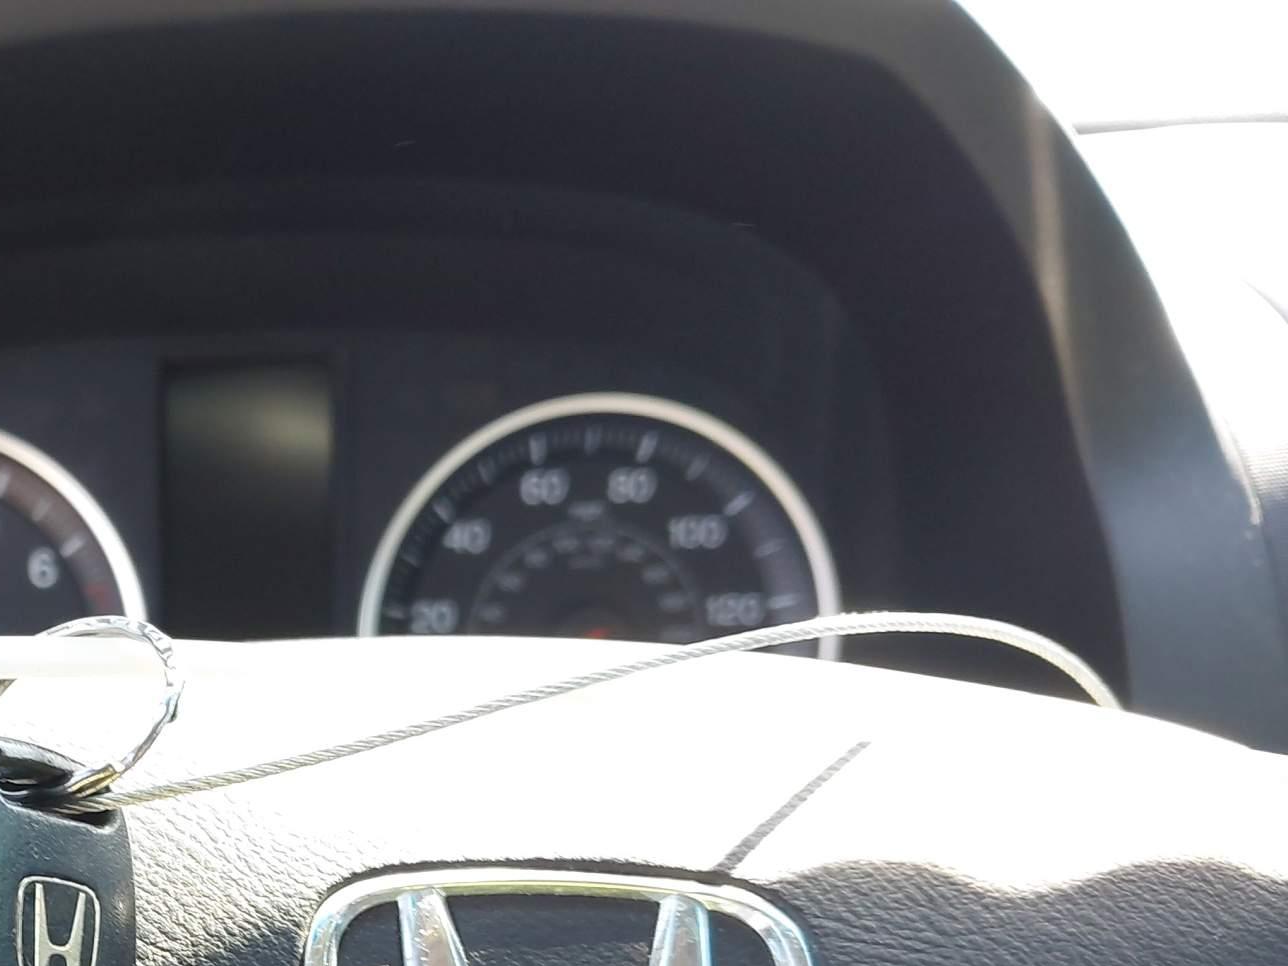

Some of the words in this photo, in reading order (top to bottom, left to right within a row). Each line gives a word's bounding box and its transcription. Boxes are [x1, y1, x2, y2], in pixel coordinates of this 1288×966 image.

[520, 467, 570, 505] 60
[608, 466, 657, 505] 80
[443, 517, 492, 554] 40
[668, 515, 728, 549] 100
[27, 545, 58, 589] 6
[411, 598, 460, 634] 20
